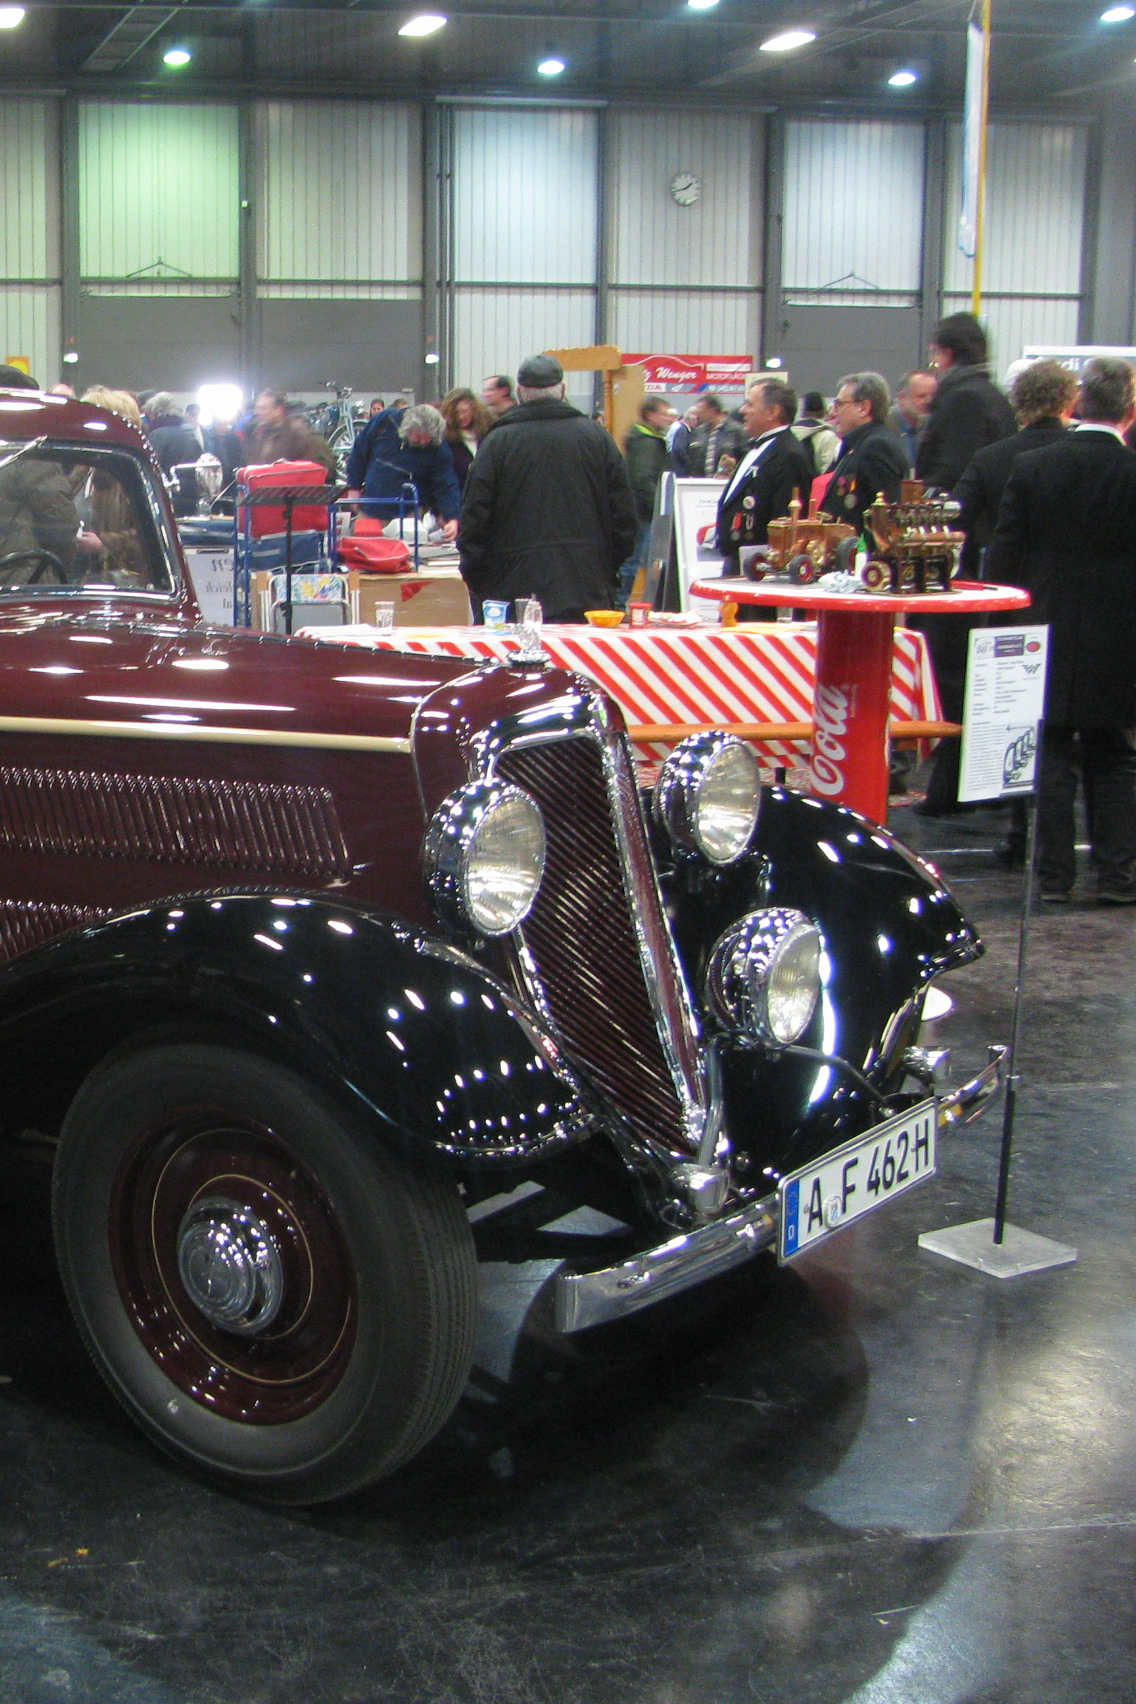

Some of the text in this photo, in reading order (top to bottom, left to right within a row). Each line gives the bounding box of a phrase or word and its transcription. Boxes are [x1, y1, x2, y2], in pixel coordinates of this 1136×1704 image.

[655, 366, 696, 383] Wenger
[810, 682, 849, 796] Cola
[807, 1118, 929, 1234] A F 462H
[787, 1225, 795, 1241] D
